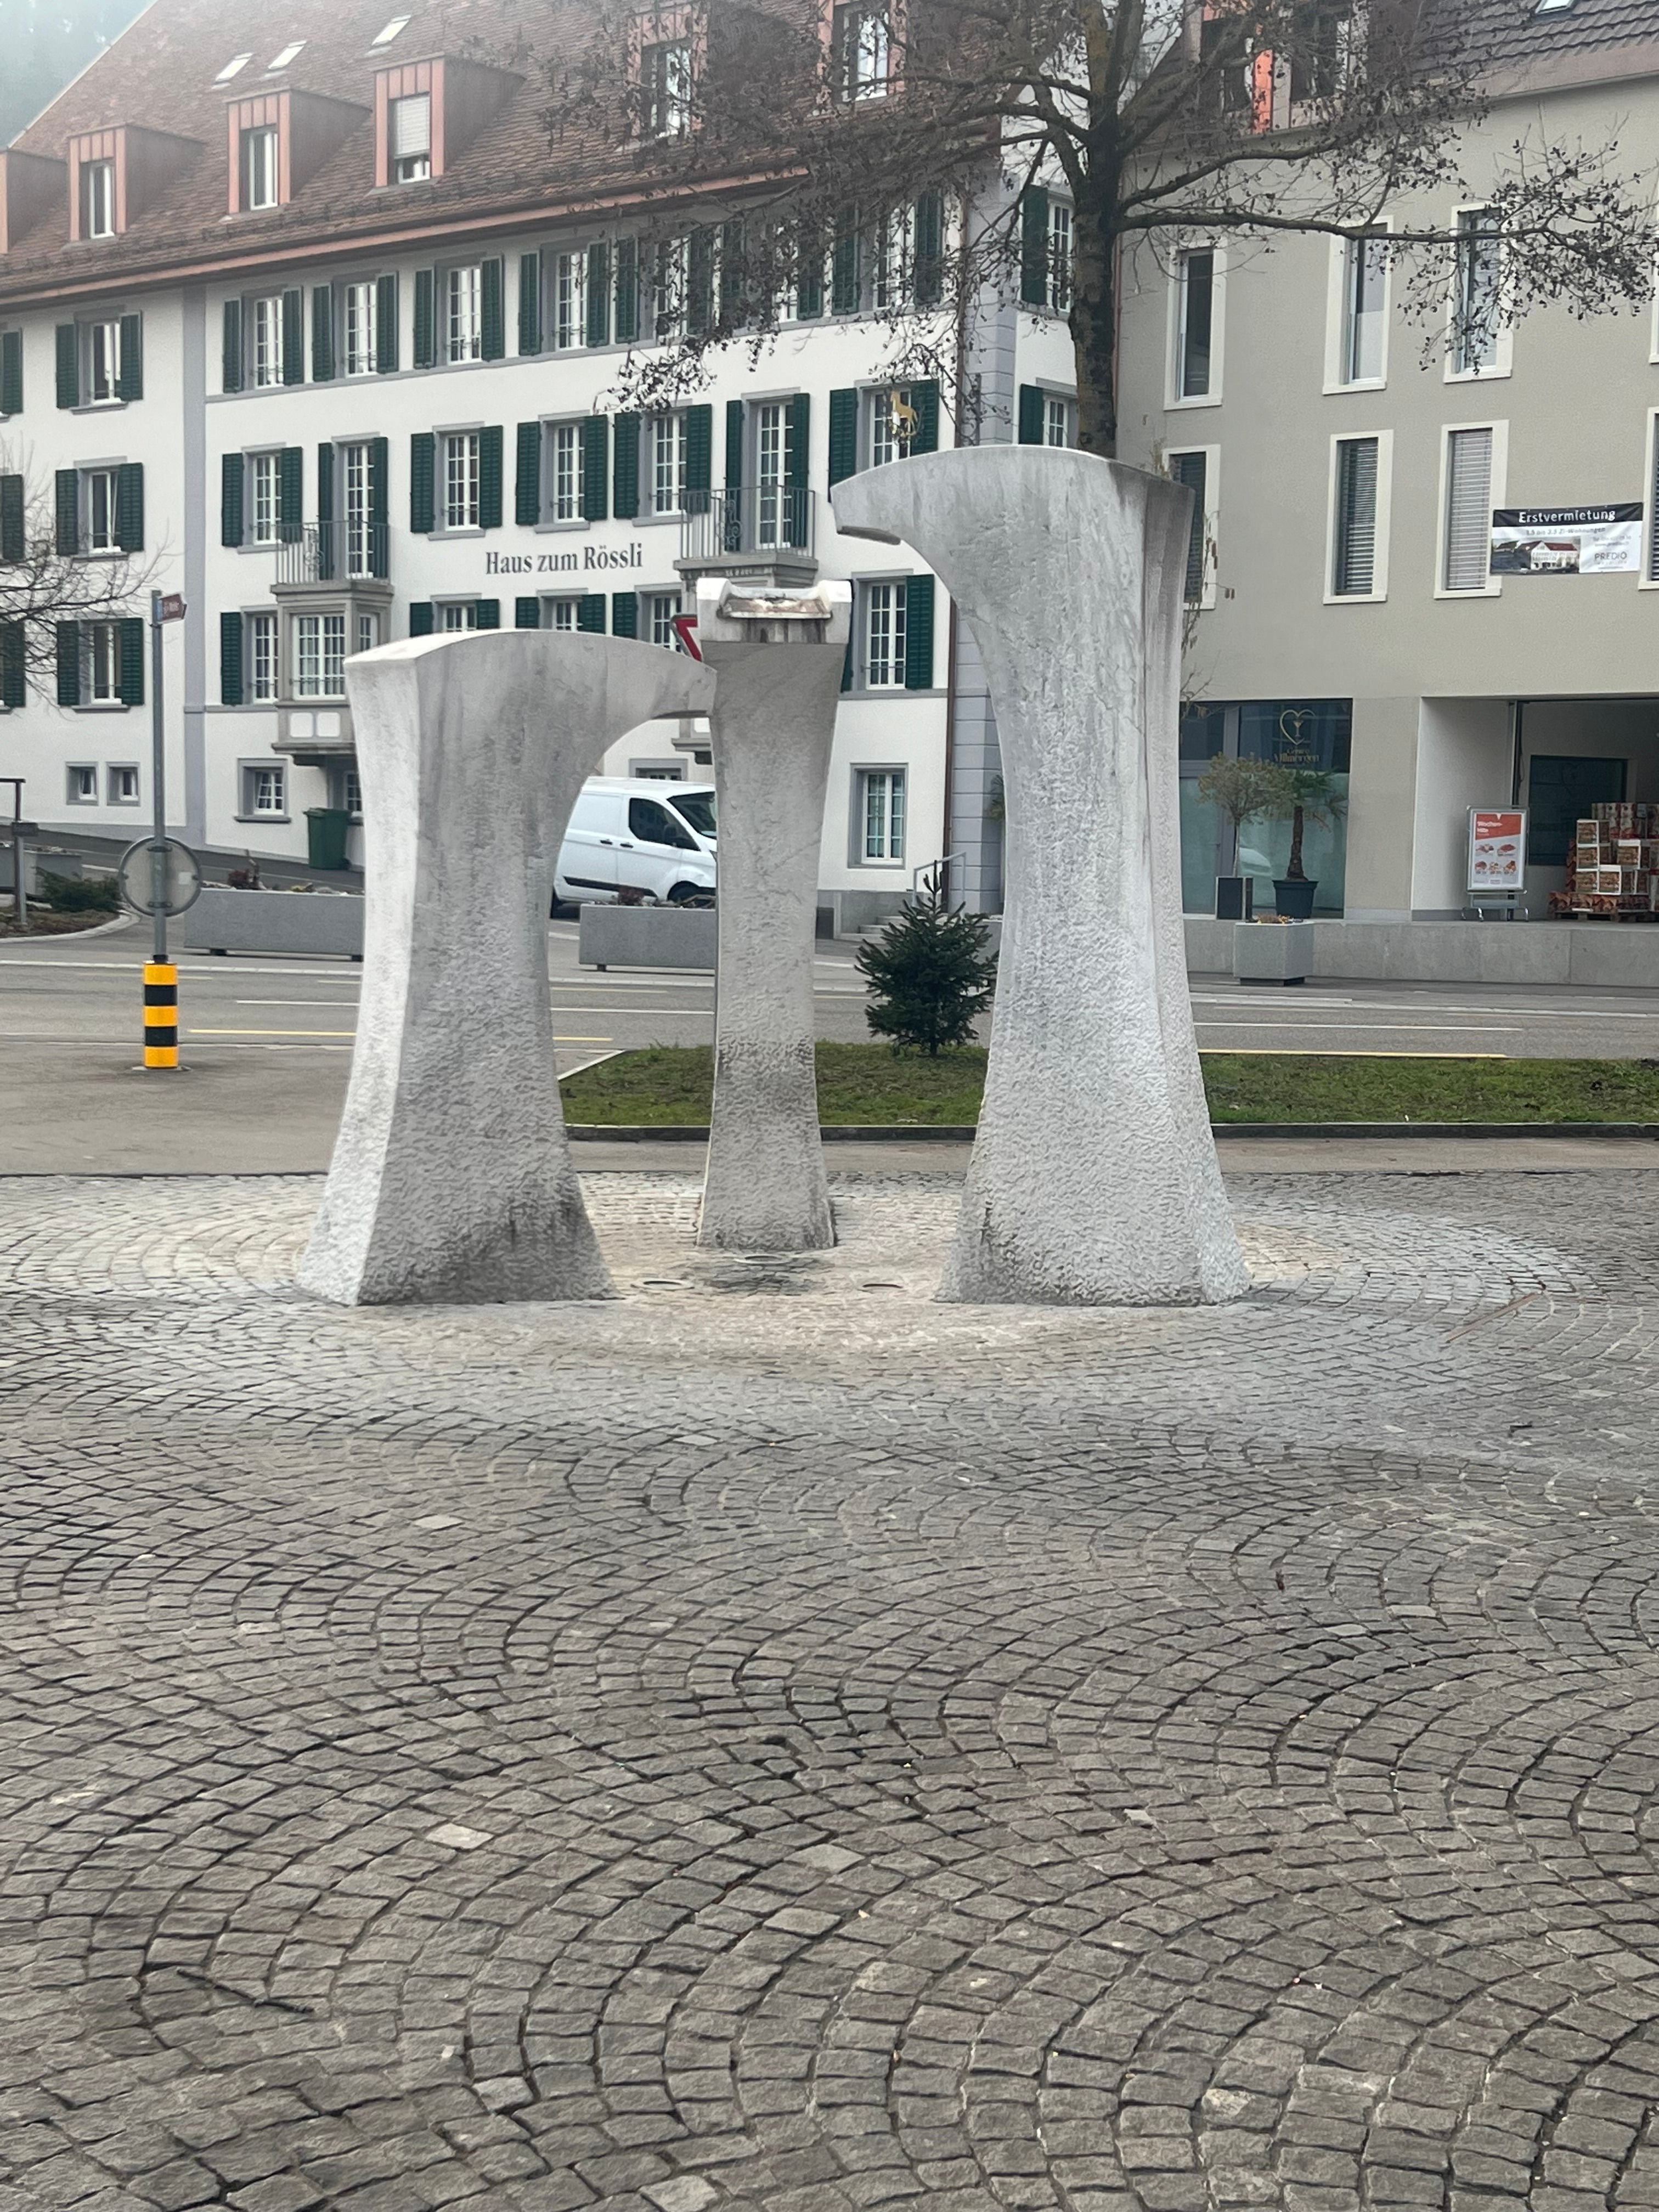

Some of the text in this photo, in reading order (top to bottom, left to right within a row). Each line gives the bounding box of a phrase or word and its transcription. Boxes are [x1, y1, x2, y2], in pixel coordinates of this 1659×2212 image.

[1519, 510, 1616, 523] Erstvermietung
[486, 543, 643, 575] Haus zum Rössli
[1594, 551, 1627, 561] PREDIO
